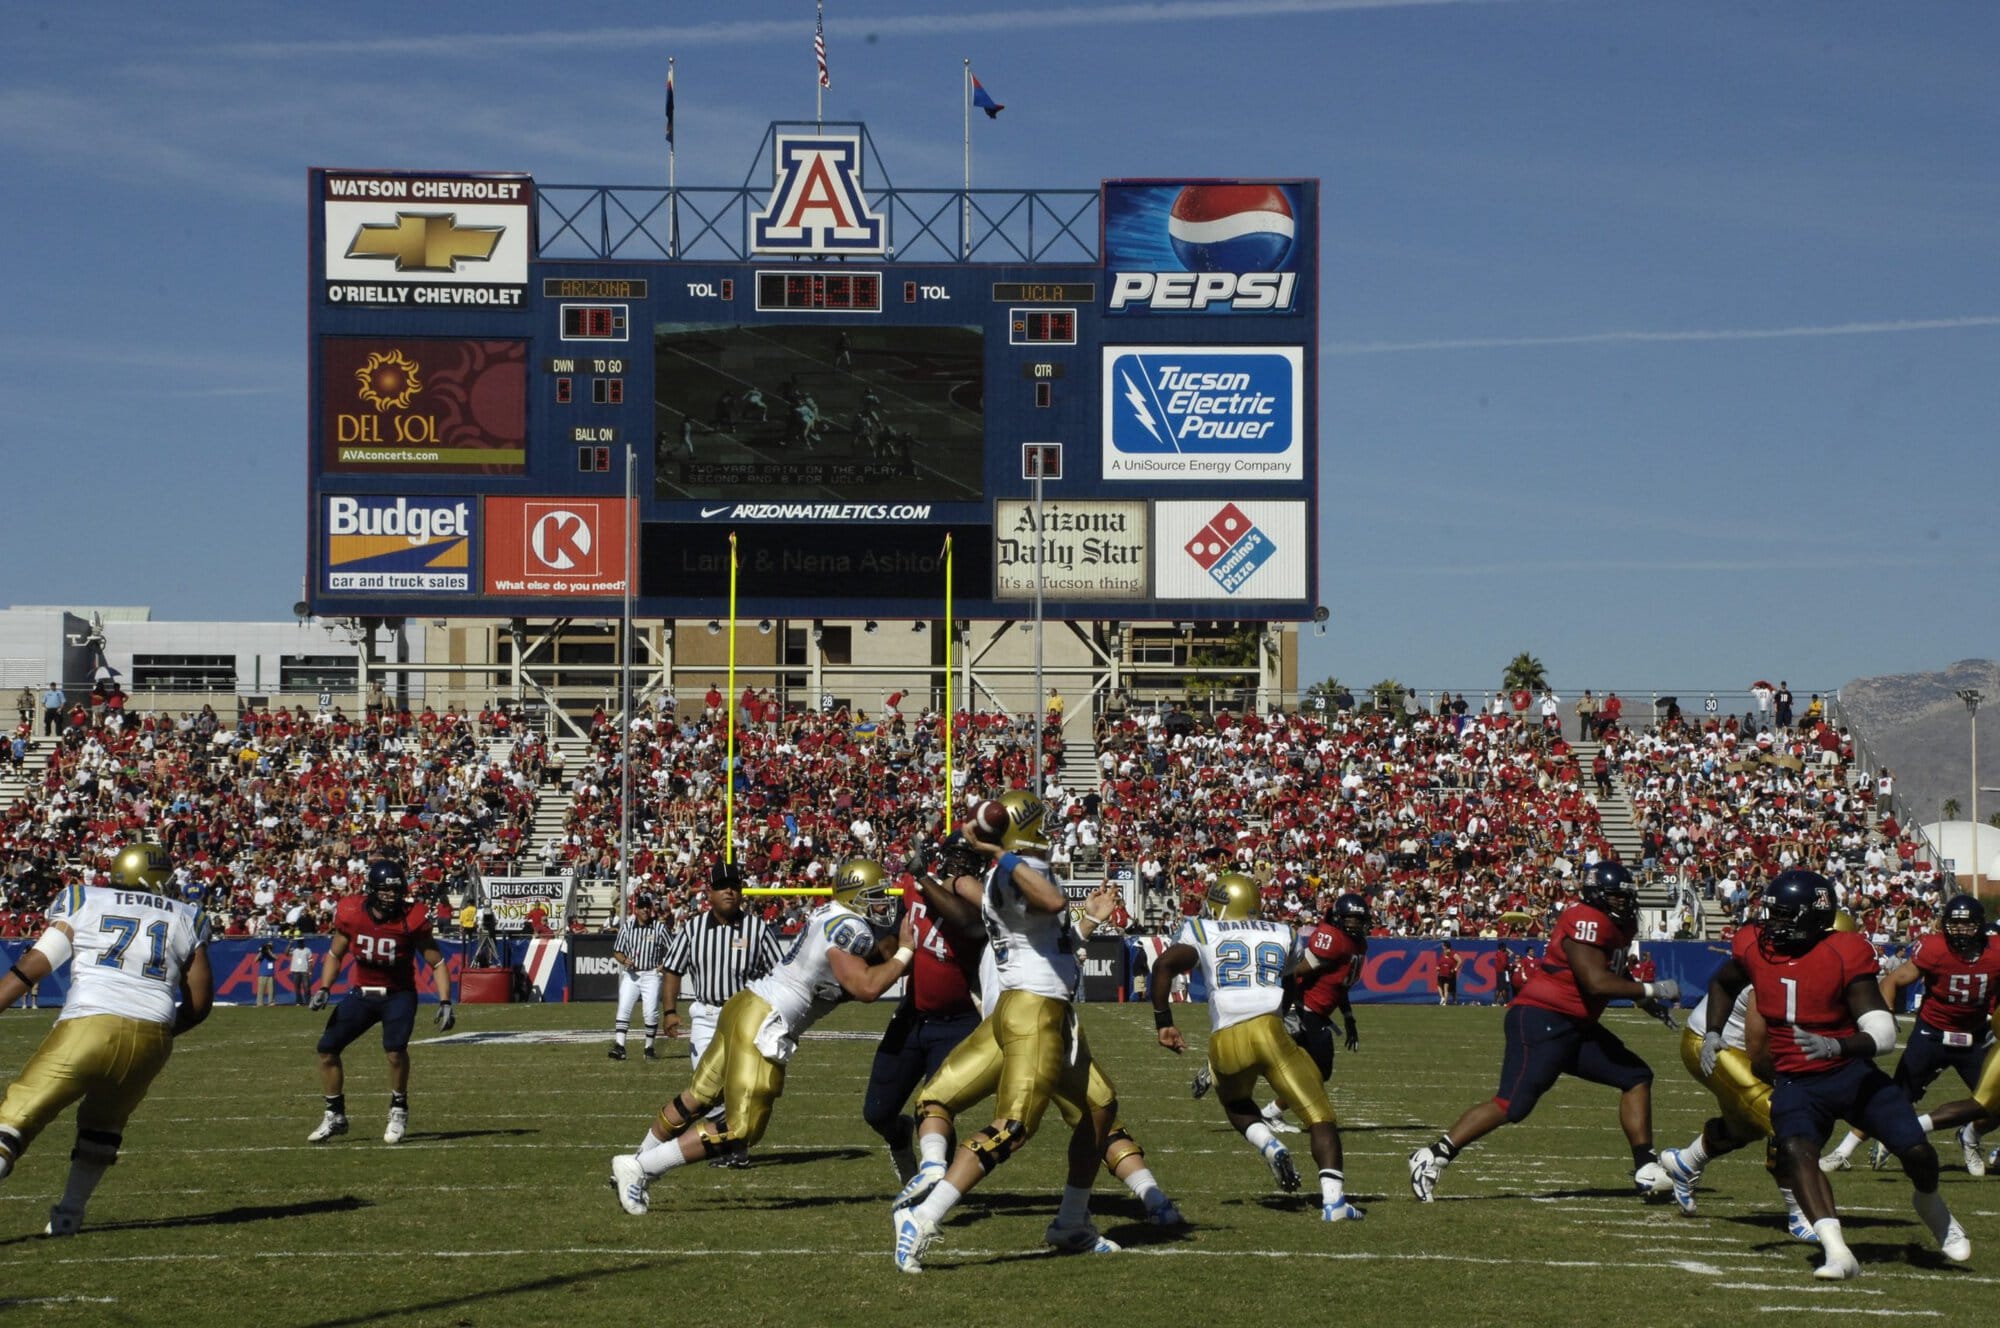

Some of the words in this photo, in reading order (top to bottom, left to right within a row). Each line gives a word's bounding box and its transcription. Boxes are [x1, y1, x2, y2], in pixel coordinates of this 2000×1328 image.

[331, 180, 406, 197] WATSON
[412, 182, 521, 199] CHEVROLET
[751, 135, 885, 253] A
[329, 286, 408, 303] O'RIELLY
[414, 288, 521, 304] CHEVROLET
[562, 282, 629, 297] ARIZONA
[688, 284, 717, 297] TOL
[921, 286, 950, 299] TOL
[1022, 285, 1063, 301] UCLA
[1110, 272, 1296, 309] PEPSI
[578, 309, 612, 335] 10
[1041, 312, 1073, 339] 14
[553, 359, 575, 373] DWN
[593, 360, 606, 373] TO
[608, 360, 622, 373] GO
[1034, 364, 1052, 377] QTR
[1158, 366, 1250, 391] Tucson
[1167, 391, 1275, 414] Electric
[338, 414, 383, 442] DEL
[394, 414, 440, 442] SOL
[575, 428, 597, 441] BALL
[599, 428, 613, 441] ON
[1178, 416, 1274, 439] Power
[342, 451, 439, 461] AVAconcerts.com
[832, 466, 855, 474] THE
[1112, 460, 1120, 470] A
[1124, 460, 1186, 471] UniSource
[1189, 460, 1231, 473] Energy
[1234, 460, 1291, 473] Company
[730, 504, 931, 519] ARIZONAATHLETICS.COM
[1014, 505, 1127, 532] Arizona
[330, 497, 468, 545] Budget
[783, 551, 843, 572] Nena
[997, 537, 1074, 571] Daily
[1080, 537, 1143, 565] Star
[1211, 534, 1261, 580] Domino's
[332, 577, 354, 587] car
[359, 576, 383, 587] and
[389, 576, 424, 588] truck
[429, 576, 465, 588] sales
[999, 576, 1020, 589] It's
[1026, 579, 1035, 589] a
[1041, 576, 1093, 589] Tucson
[1222, 561, 1256, 591] Pizza
[495, 581, 525, 590] What
[527, 581, 550, 590] else
[553, 581, 567, 590] do
[570, 583, 589, 592] you
[592, 581, 626, 591] need?
[320, 694, 330, 705] 27
[823, 696, 833, 706] 28
[1315, 698, 1325, 708] 29
[1705, 700, 1717, 711] 30
[560, 868, 574, 876] 28
[1118, 871, 1131, 879] 29
[1662, 875, 1676, 883] 30
[492, 884, 562, 897] BRUEGGER'S
[115, 893, 173, 912] TEVAGA
[1217, 920, 1277, 932] MARKEY
[96, 915, 169, 981] 71
[1315, 932, 1332, 949] 33
[356, 934, 396, 967] 39
[575, 956, 620, 974] MUSC
[1216, 940, 1285, 987] 28
[1949, 973, 1989, 1006] 51
[1780, 977, 1797, 1025] 1
